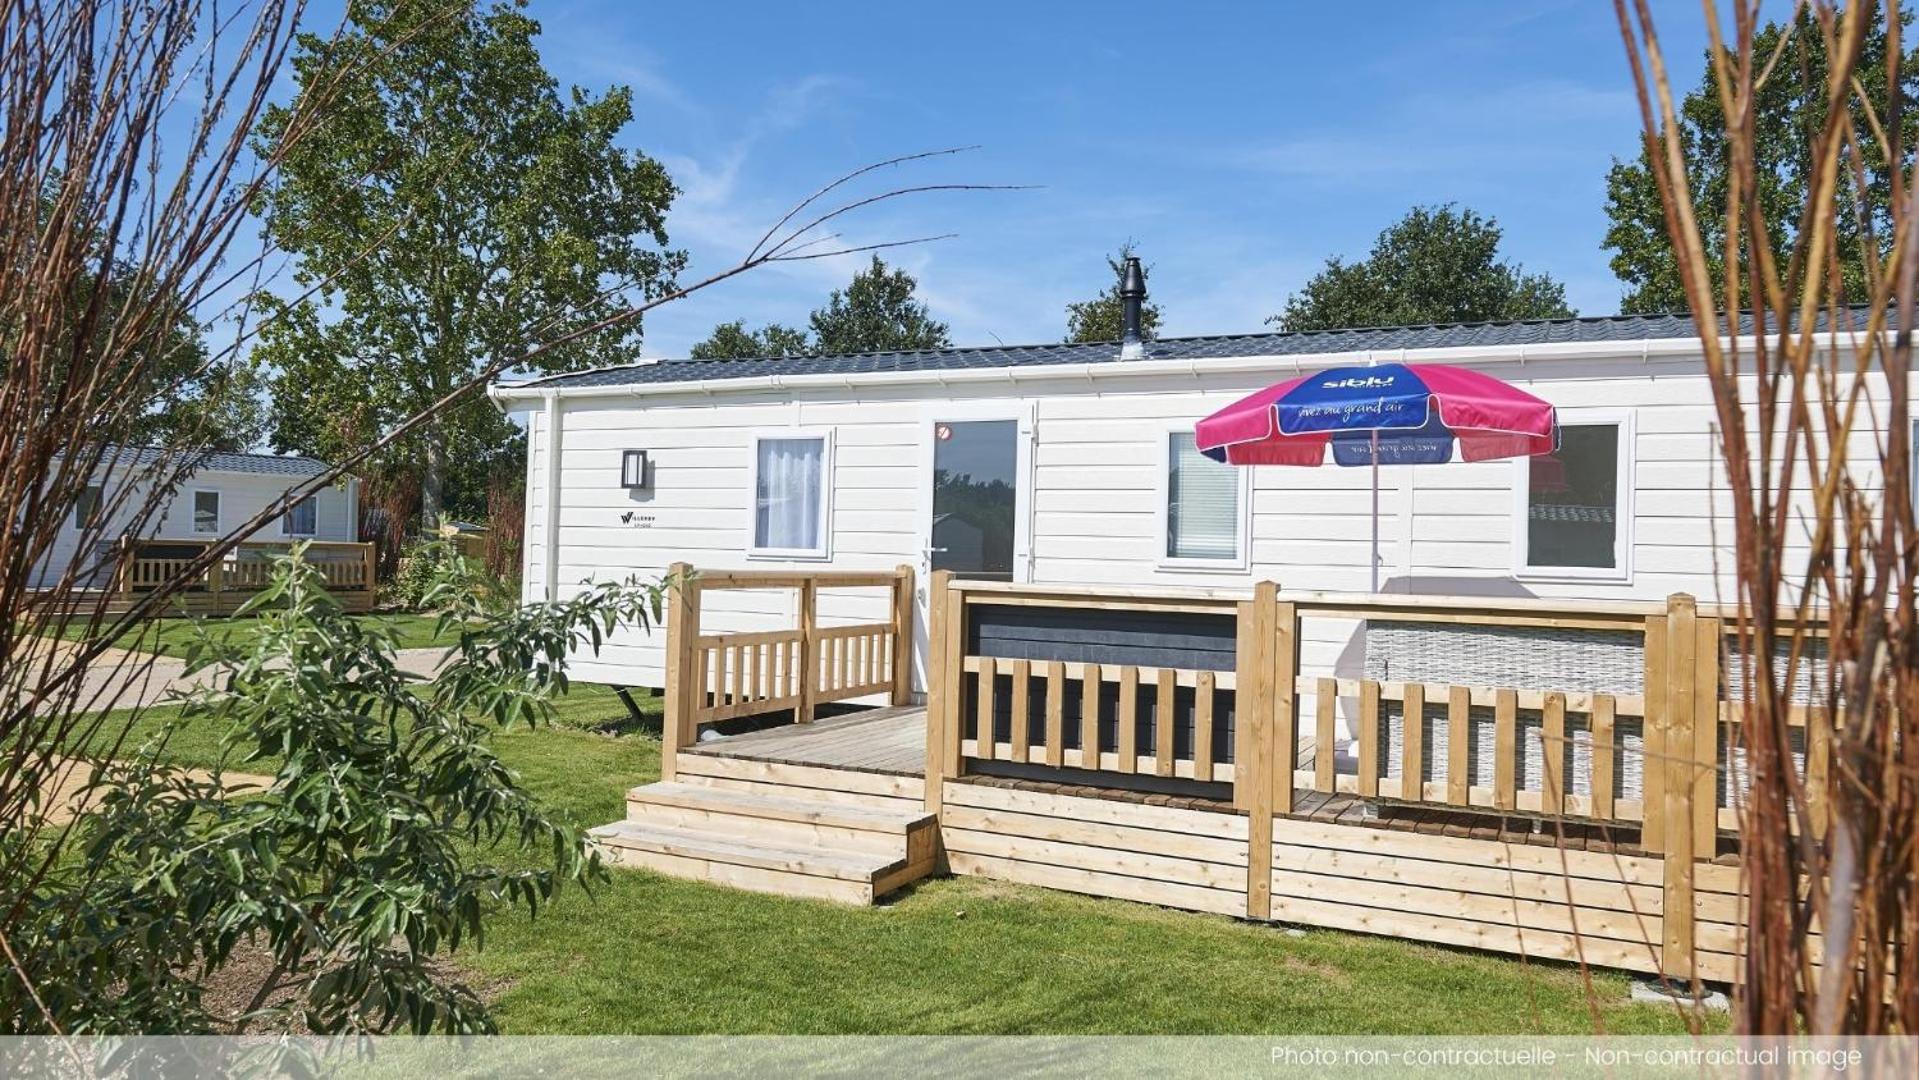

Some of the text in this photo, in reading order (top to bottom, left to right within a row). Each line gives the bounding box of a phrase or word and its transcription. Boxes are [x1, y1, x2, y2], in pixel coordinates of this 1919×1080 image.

[1322, 377, 1394, 388] siblu
[1324, 406, 1341, 415] au
[1343, 397, 1384, 422] grand
[1385, 401, 1404, 413] air
